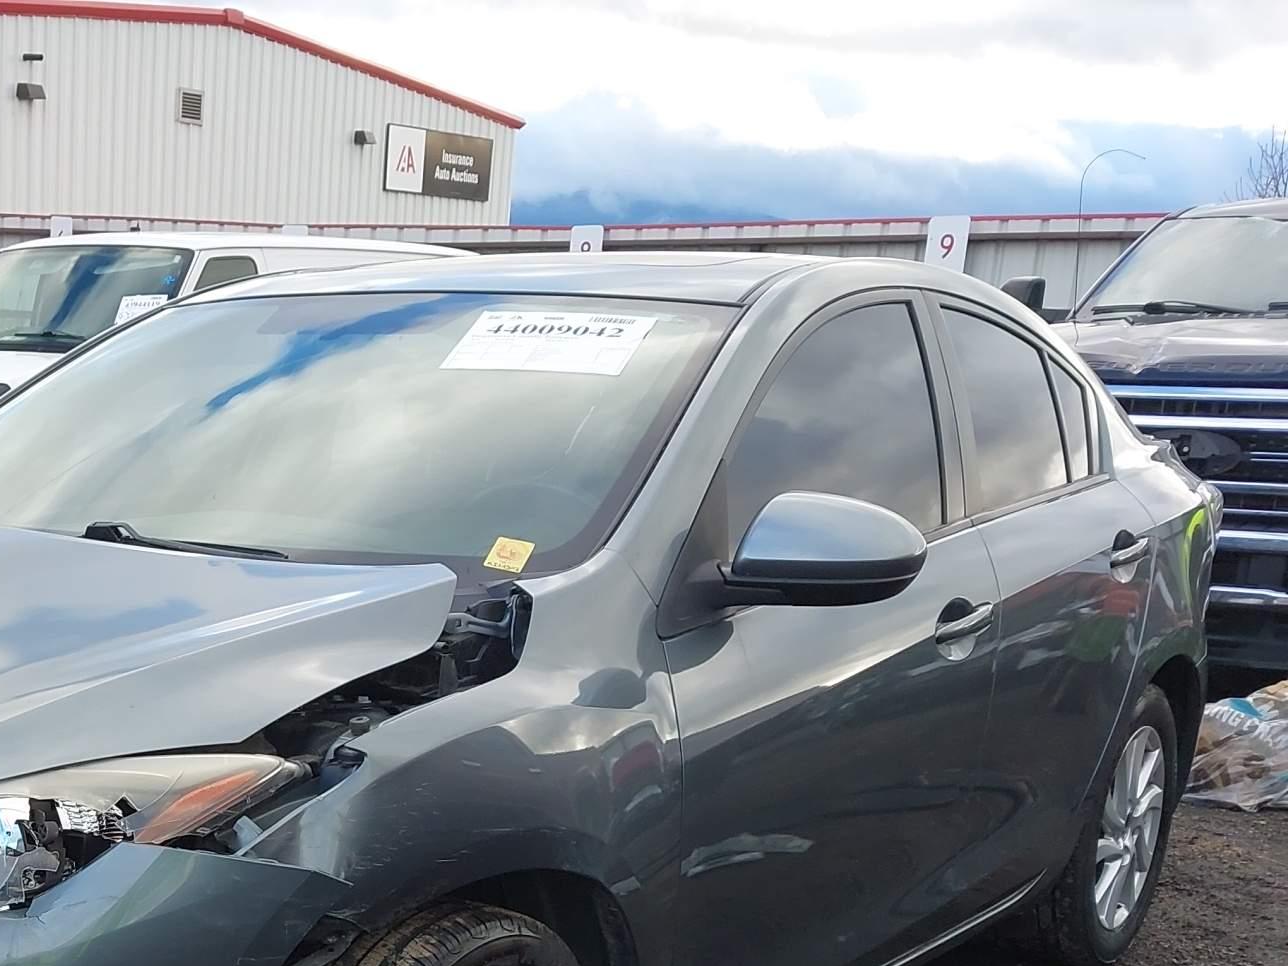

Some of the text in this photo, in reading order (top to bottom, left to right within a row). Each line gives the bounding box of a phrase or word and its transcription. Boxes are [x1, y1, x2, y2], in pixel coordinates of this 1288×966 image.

[442, 149, 474, 167] Insurance
[434, 165, 479, 184] Auto Auctions
[940, 233, 955, 259] 9
[487, 323, 625, 338] 44009042
